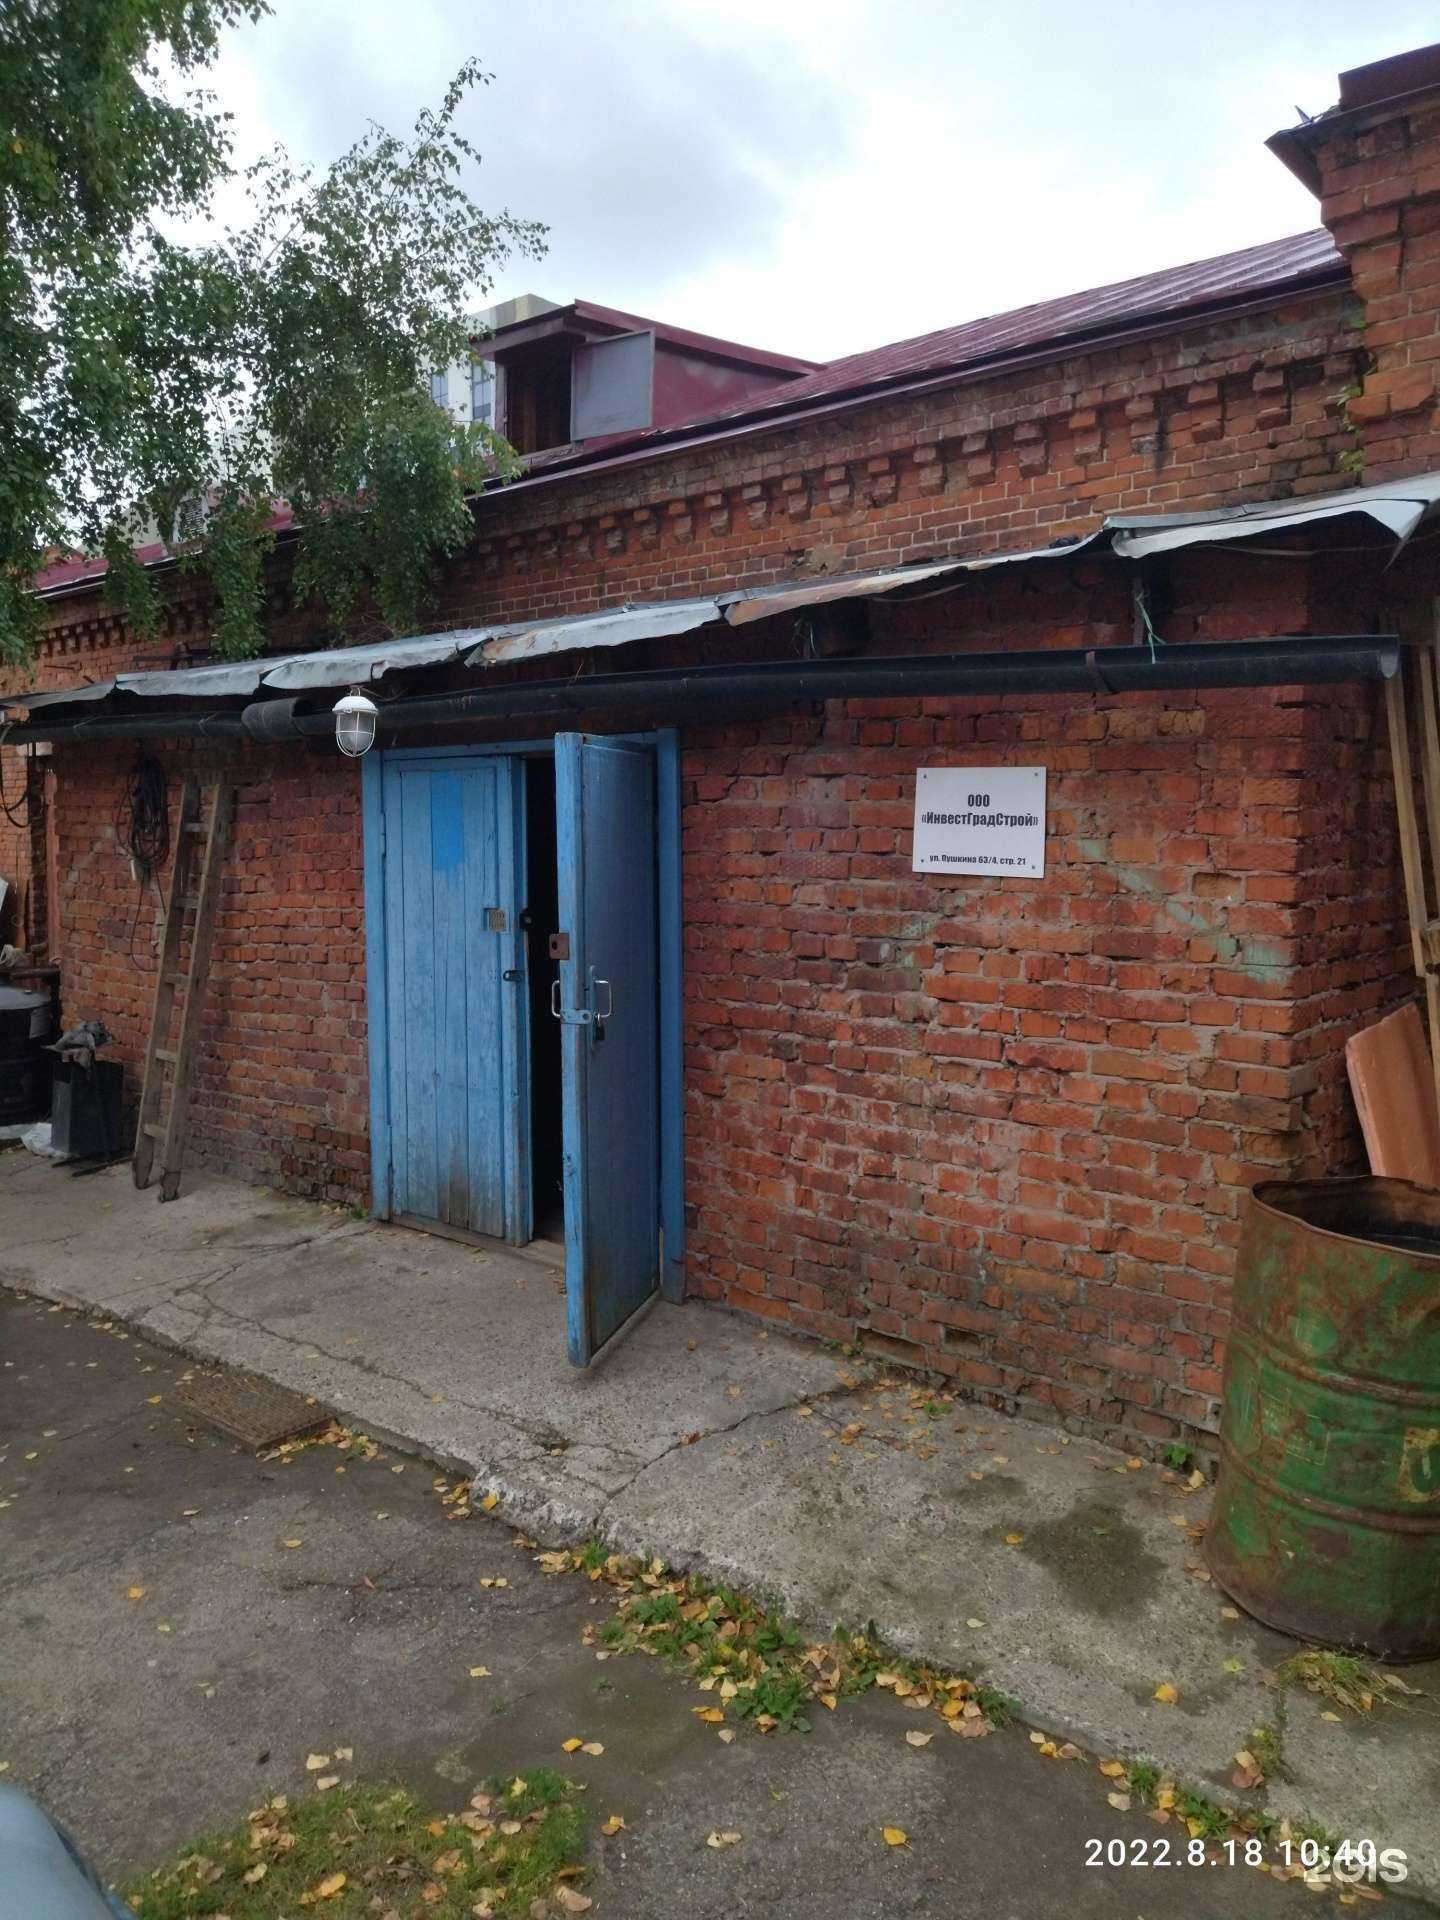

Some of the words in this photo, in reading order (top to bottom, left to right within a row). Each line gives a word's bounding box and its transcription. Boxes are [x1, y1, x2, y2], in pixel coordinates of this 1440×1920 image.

[967, 794, 990, 807] ООО
[921, 811, 1039, 827] «ИнвестГрадСтрой»
[929, 854, 940, 862] ул.
[941, 854, 977, 864] Пушкина
[999, 857, 1016, 866] стр.
[1017, 857, 1026, 865] 21
